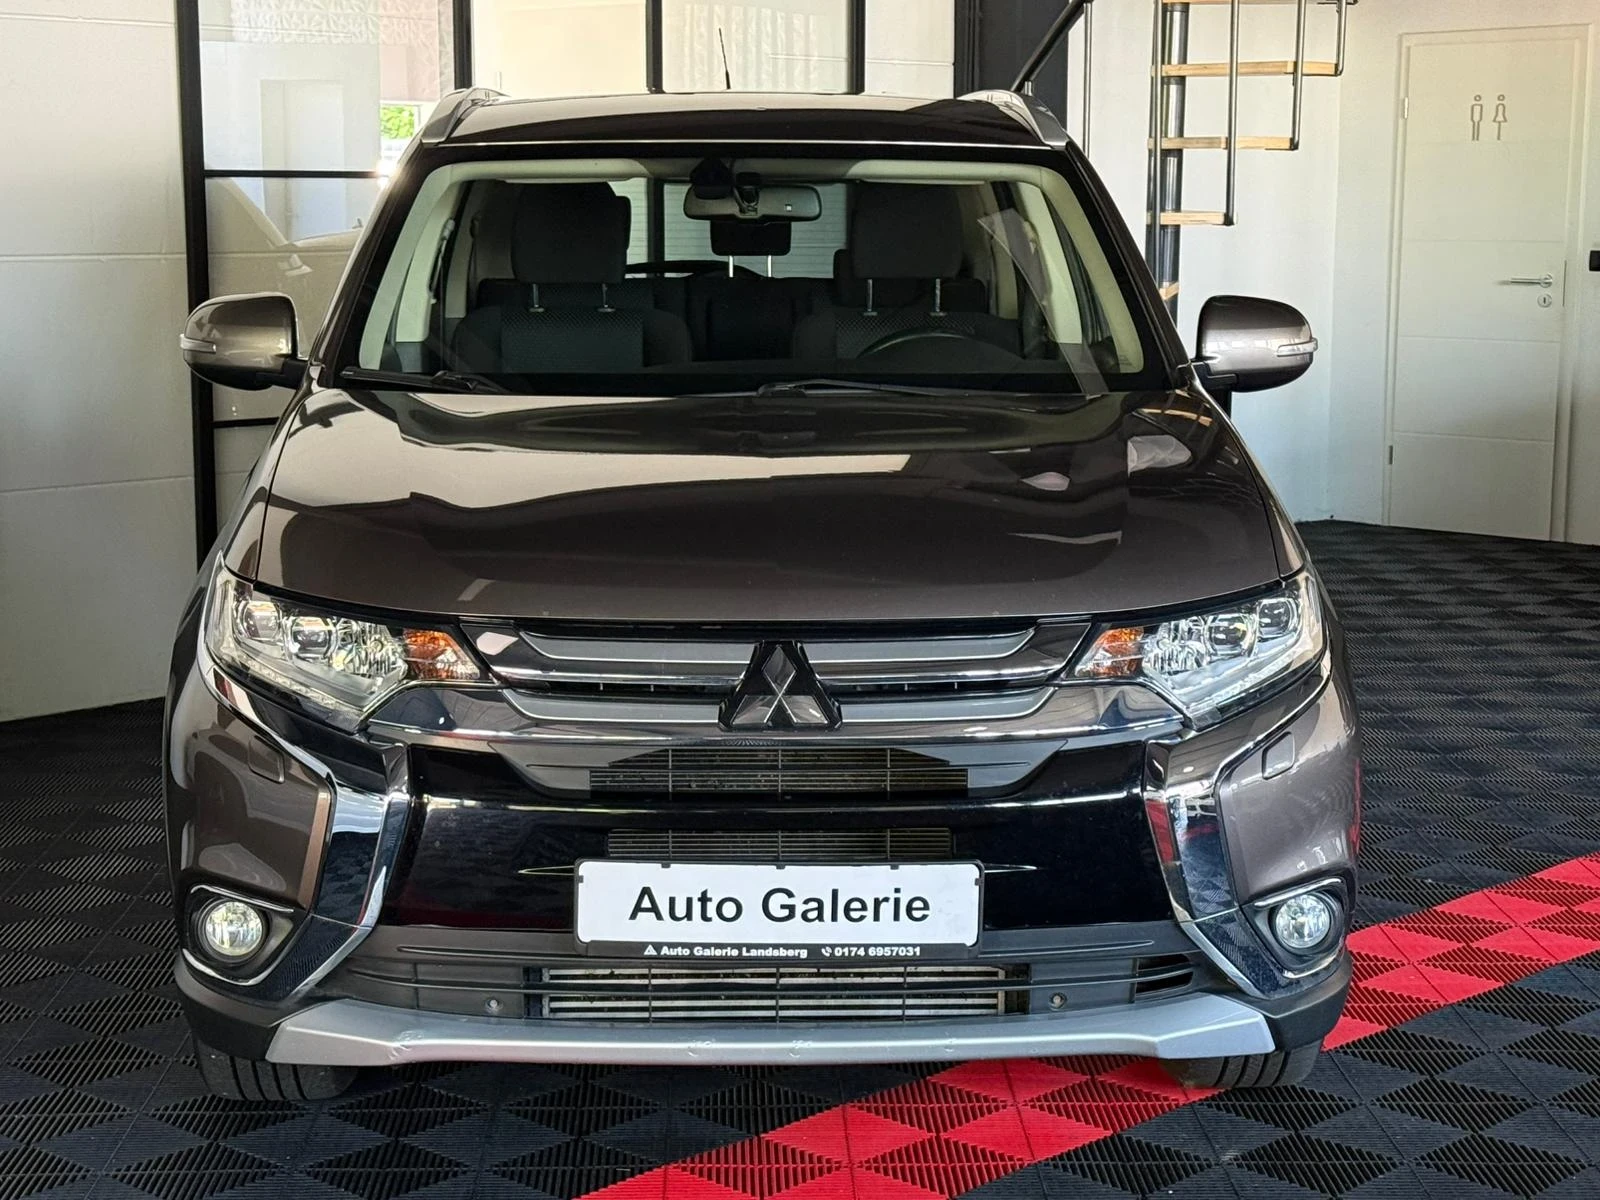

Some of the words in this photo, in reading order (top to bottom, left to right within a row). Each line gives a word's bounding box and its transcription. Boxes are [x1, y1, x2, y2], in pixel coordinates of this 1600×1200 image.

[628, 886, 743, 923] Auto
[761, 887, 931, 923] Galerie
[660, 946, 691, 957] Auto
[693, 946, 739, 957] Galerie
[742, 946, 808, 959] Landsberg
[834, 946, 865, 957] 0174
[868, 946, 921, 957] 6957031
